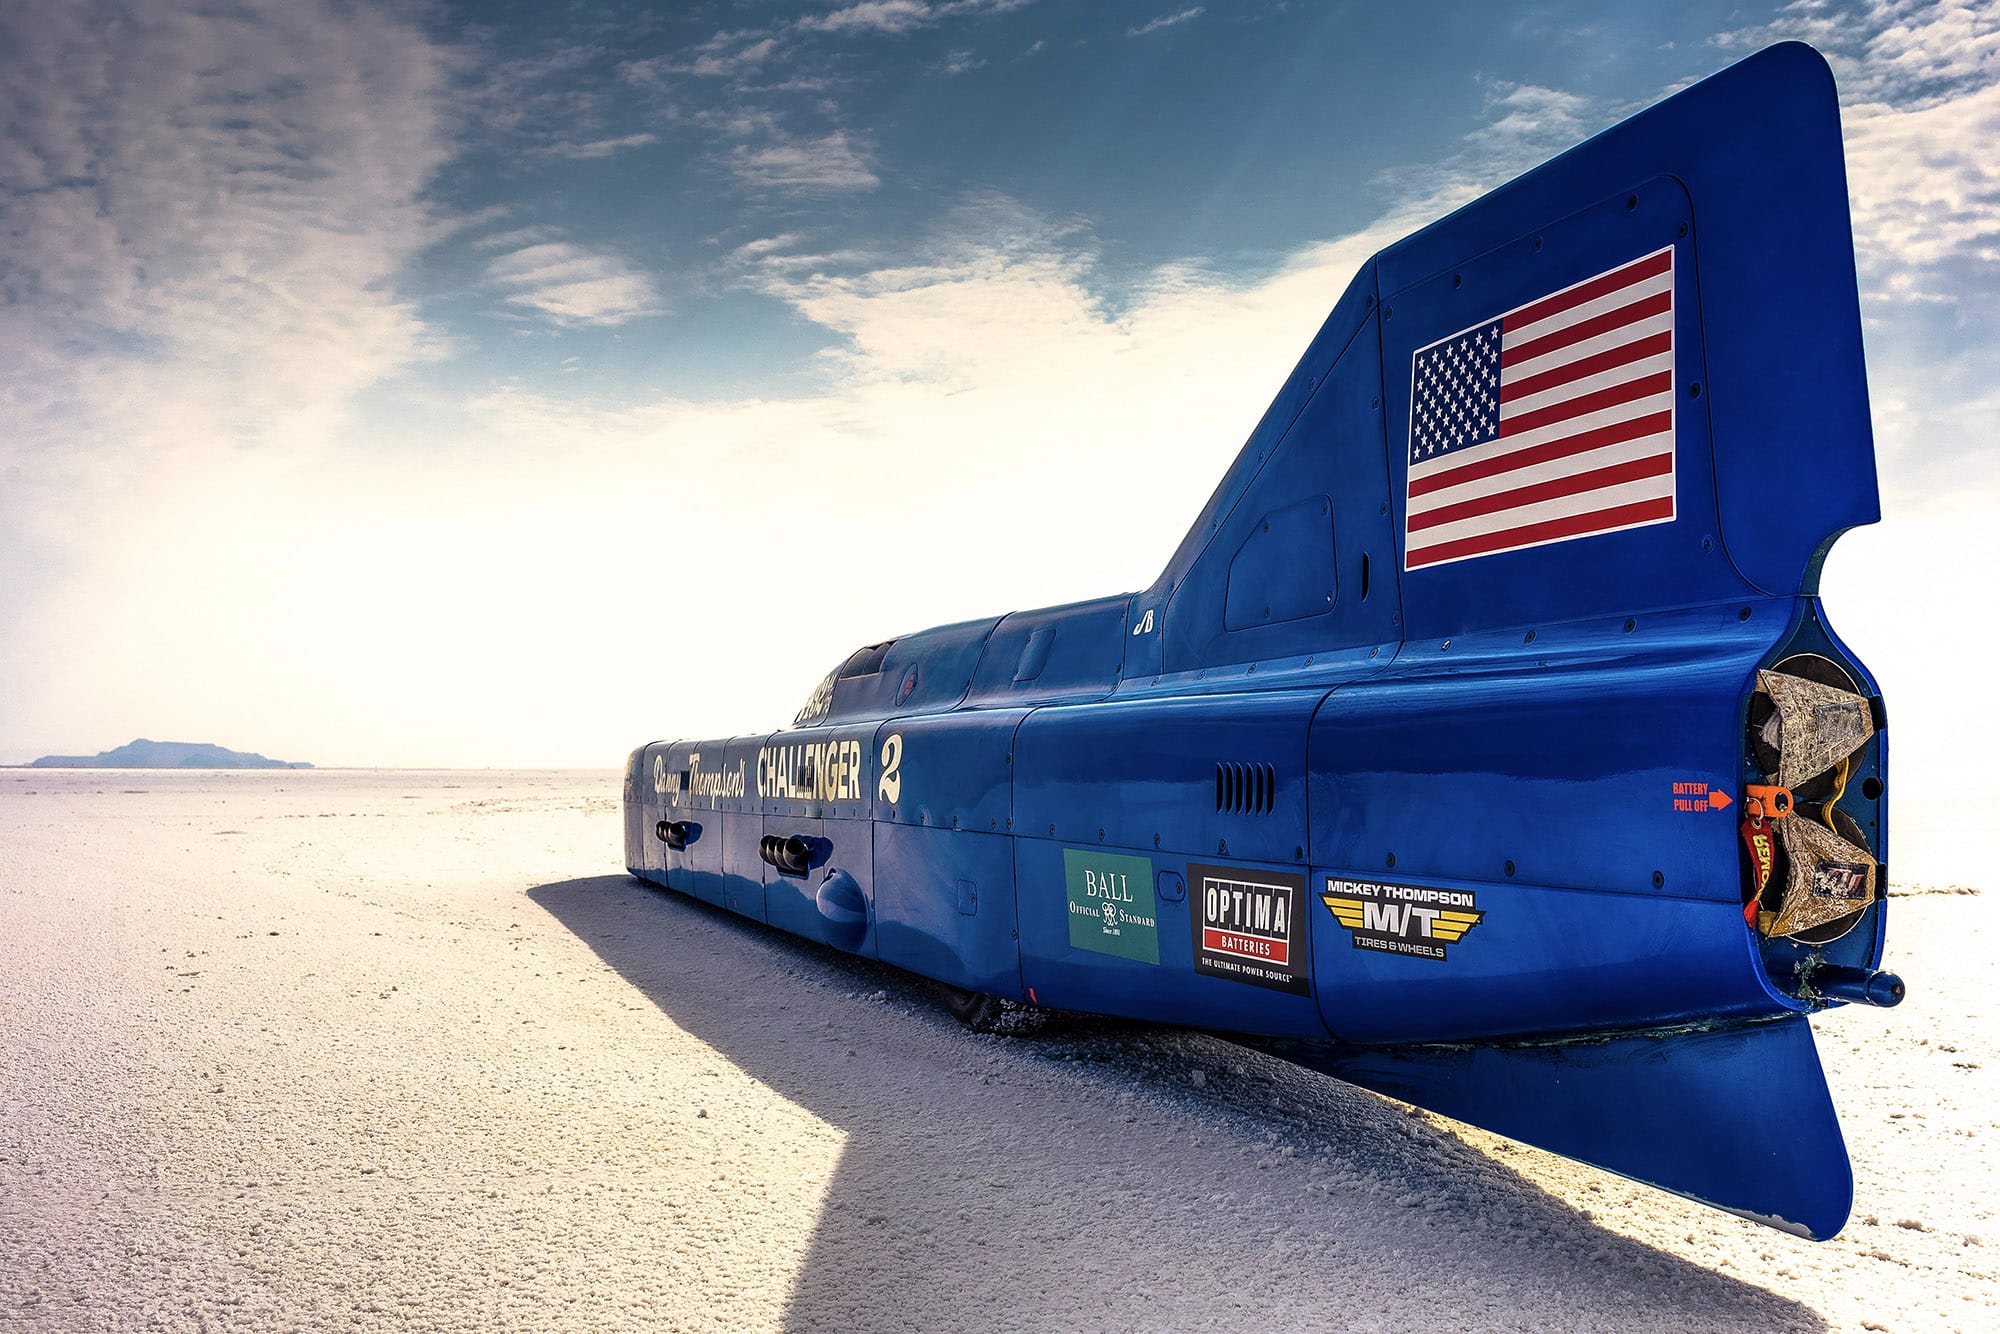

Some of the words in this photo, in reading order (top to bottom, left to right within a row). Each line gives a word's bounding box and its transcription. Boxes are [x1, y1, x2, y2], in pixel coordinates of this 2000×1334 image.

[653, 754, 680, 808] Danny
[756, 739, 861, 802] CHALLENGER
[878, 733, 903, 805] 2
[1672, 782, 1709, 796] BATTERY
[1673, 799, 1693, 812] PULL
[1694, 800, 1709, 813] OFF
[1085, 870, 1133, 903] BALL
[1327, 880, 1381, 897] MICKEY
[1383, 886, 1473, 907] THOMPSON
[1069, 900, 1100, 918] OFFICIAL
[1119, 908, 1155, 928] STANDARD
[1206, 887, 1286, 934] OPTIMA
[1363, 901, 1440, 938] M/T
[1221, 935, 1271, 956] BATTERIES
[1354, 936, 1387, 950] TIRES
[1388, 941, 1397, 951] &
[1398, 943, 1445, 958] WHEELS
[1202, 957, 1212, 967] THE
[1213, 959, 1241, 973] ULTIMATE
[1242, 965, 1264, 978] POWER
